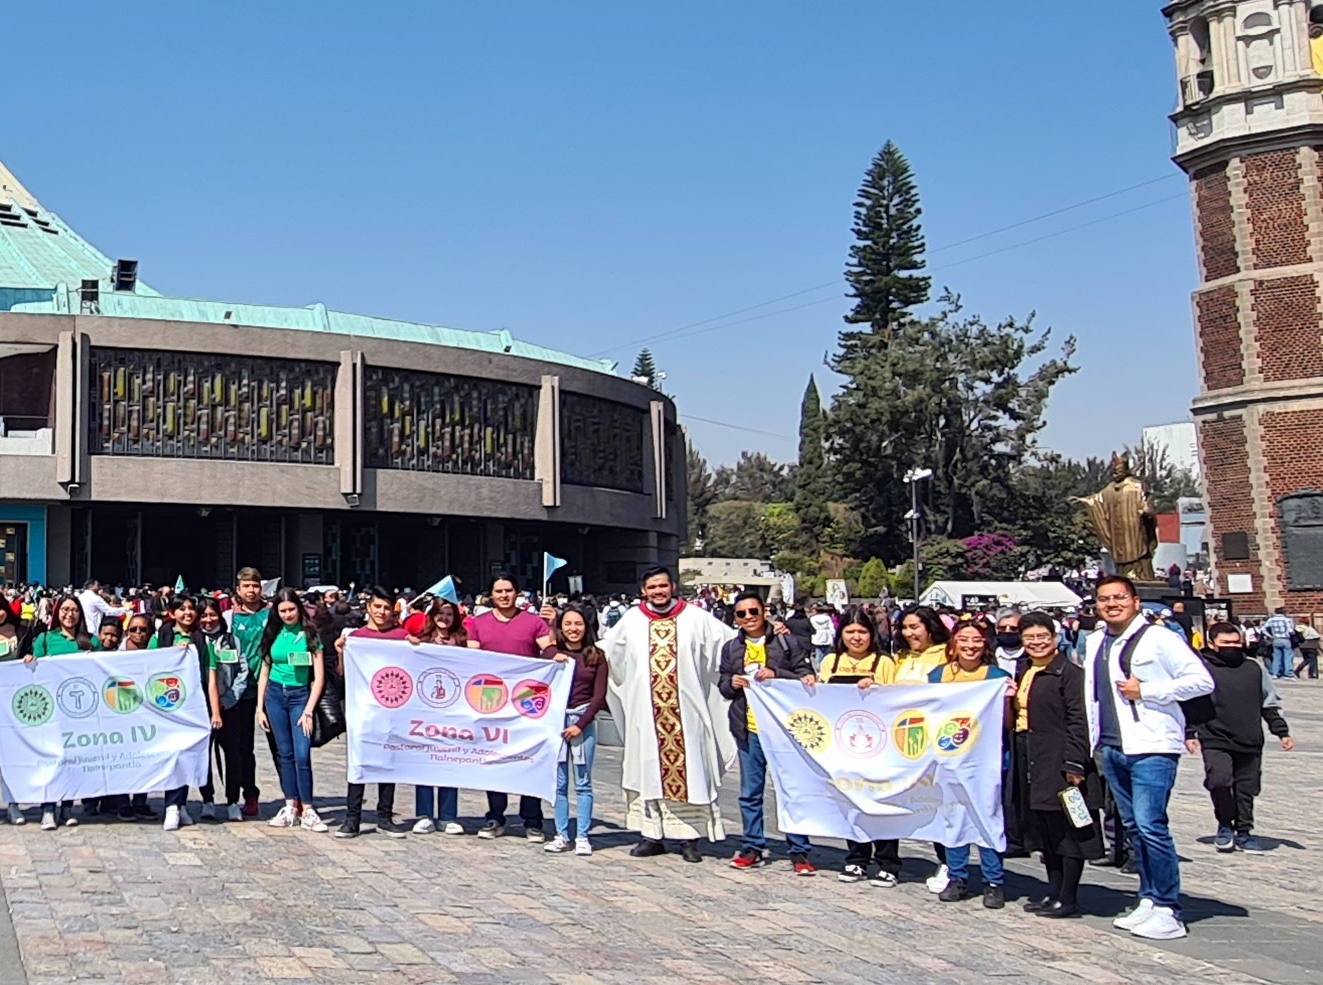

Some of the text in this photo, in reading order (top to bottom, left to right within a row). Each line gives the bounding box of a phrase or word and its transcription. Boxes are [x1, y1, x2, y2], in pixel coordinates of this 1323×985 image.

[62, 724, 157, 749] Zona IV
[409, 720, 508, 744] Zona VI
